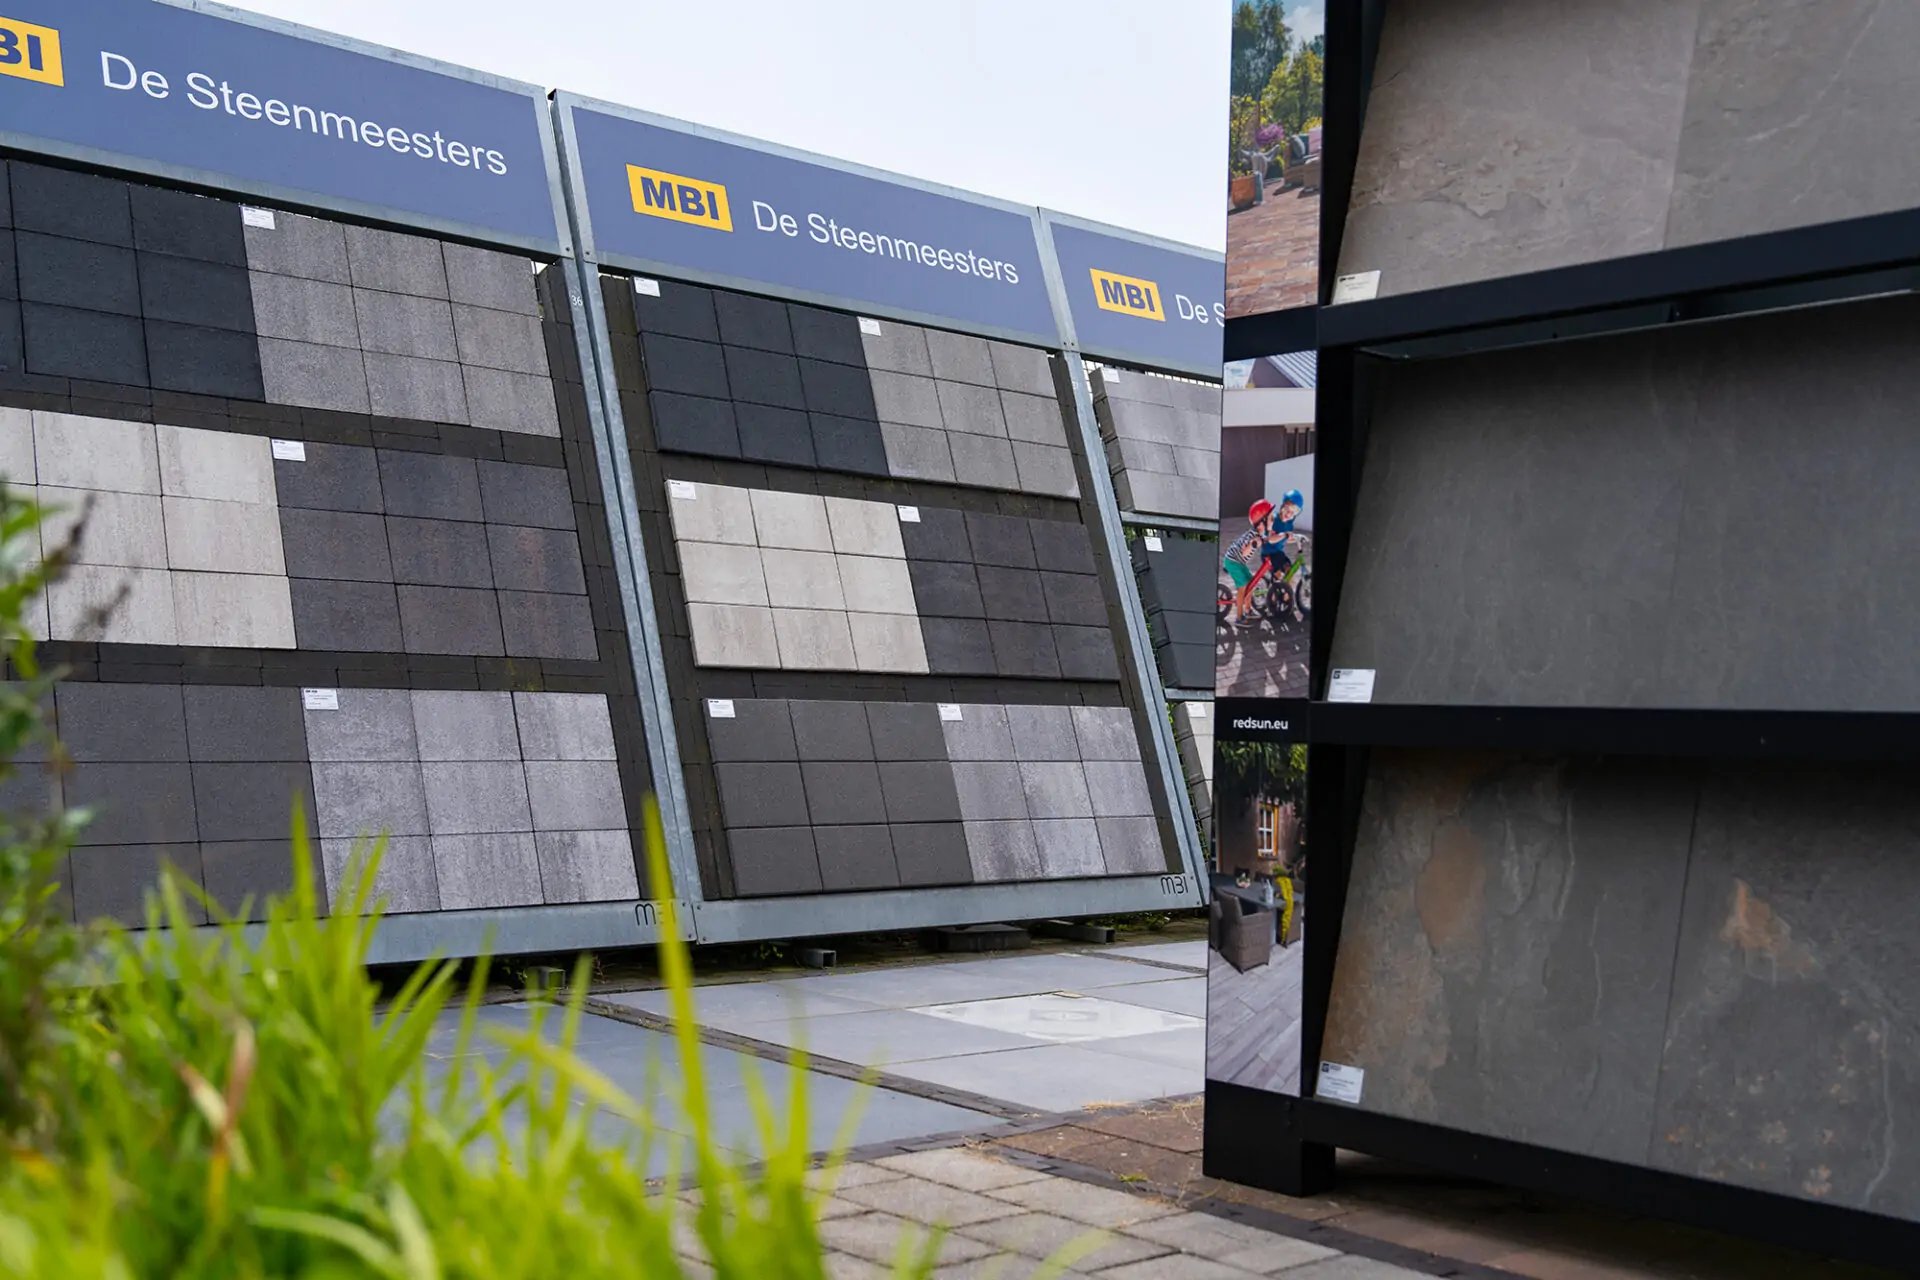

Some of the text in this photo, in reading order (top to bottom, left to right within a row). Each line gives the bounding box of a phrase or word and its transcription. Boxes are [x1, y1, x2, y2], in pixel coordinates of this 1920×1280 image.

[0, 28, 44, 72] BI
[100, 51, 507, 175] De Steenmeesters
[640, 176, 720, 221] MBI
[752, 200, 1019, 284] De Steenmeesters
[1100, 278, 1155, 312] MBI
[1175, 294, 1209, 324] De
[1233, 716, 1289, 730] redsun.eu
